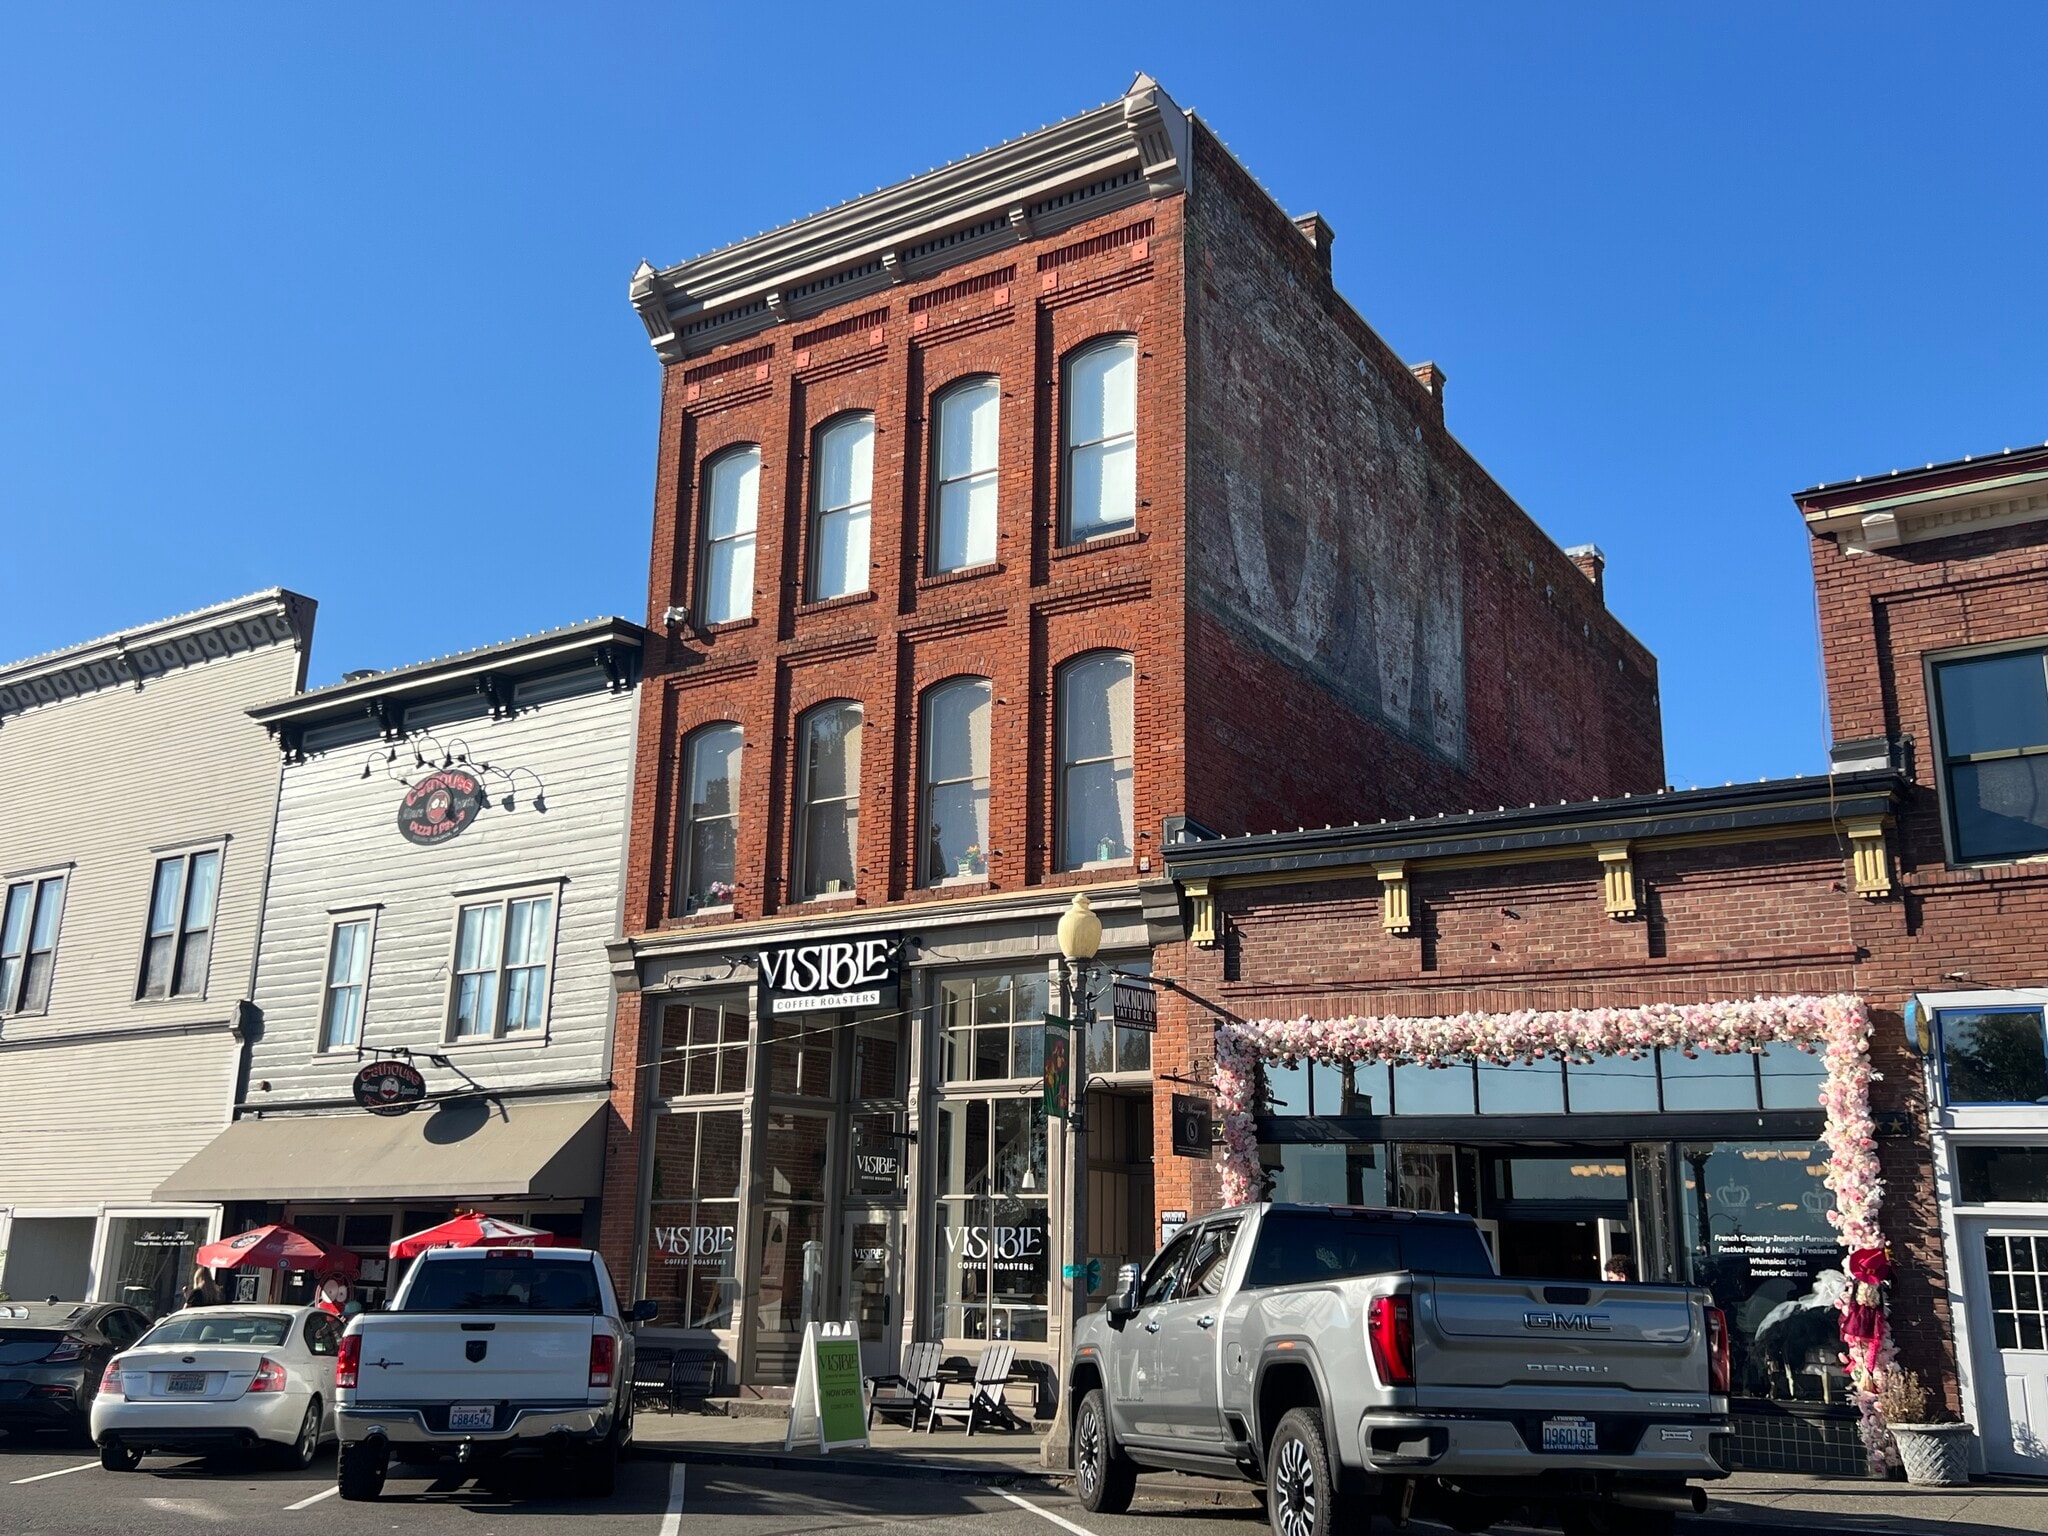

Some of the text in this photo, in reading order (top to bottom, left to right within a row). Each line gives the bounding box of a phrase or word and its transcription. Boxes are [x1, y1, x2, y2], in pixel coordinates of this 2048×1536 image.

[759, 939, 889, 992] VISIBLE
[777, 993, 876, 1010] COFFEE ROASTERS
[1114, 986, 1156, 1012] UNKNOWN
[1116, 1006, 1141, 1020] TATTOO
[360, 1063, 421, 1085] Cathouse
[856, 1155, 897, 1174] VISIBLE
[655, 1226, 734, 1255] VISIBLE
[944, 1226, 1042, 1259] VISIBLE
[1714, 1234, 1739, 1242] French
[1740, 1234, 1804, 1244] Country-Inspired
[1772, 1246, 1800, 1255] Holiday
[1801, 1247, 1838, 1255] Treasures
[957, 1262, 1034, 1271] COFFEE ROASTERS
[1749, 1257, 1807, 1266] Whimsical Gifts
[1780, 1269, 1808, 1277] Garden
[1524, 1312, 1613, 1332] GMC
[819, 1353, 859, 1371] VISIBLE
[1527, 1364, 1609, 1373] DENALI
[451, 1413, 492, 1425] C88454Z
[1544, 1428, 1594, 1445] D96019E
